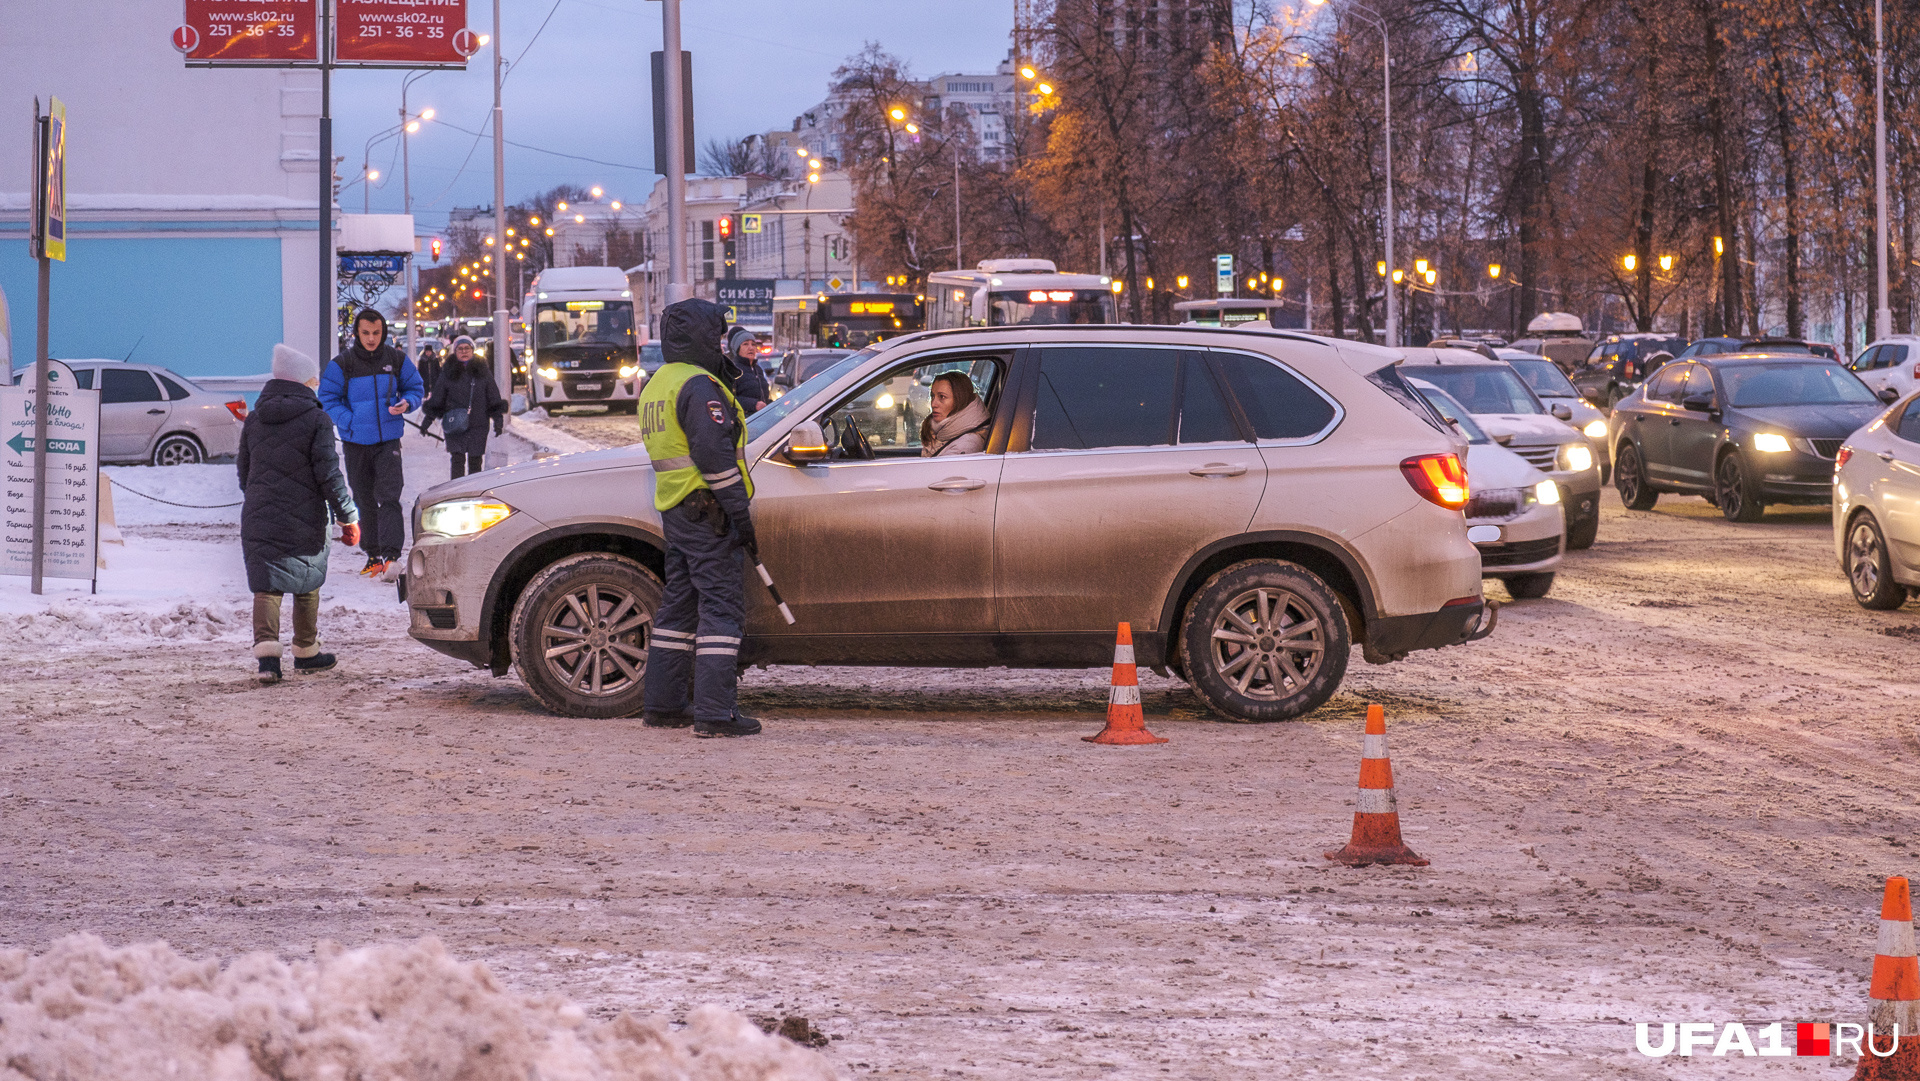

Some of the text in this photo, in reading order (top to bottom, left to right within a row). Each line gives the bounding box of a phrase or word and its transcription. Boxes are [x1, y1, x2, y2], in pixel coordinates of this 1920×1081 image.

[208, 11, 295, 22] www.sk02.ru
[358, 12, 444, 24] www.sk02.ru
[209, 24, 232, 36] 251
[246, 24, 264, 36] 36
[277, 25, 295, 36] 35
[359, 25, 382, 37] 251
[395, 26, 414, 38] 36
[426, 26, 444, 38] 35
[642, 400, 666, 440] ДПС
[48, 442, 80, 451] СЮДА
[73, 464, 88, 472] руб.
[73, 479, 88, 487] руб.
[73, 494, 87, 502] руб.
[72, 509, 86, 518] руб.
[72, 524, 86, 533] руб.
[72, 539, 86, 548] руб.
